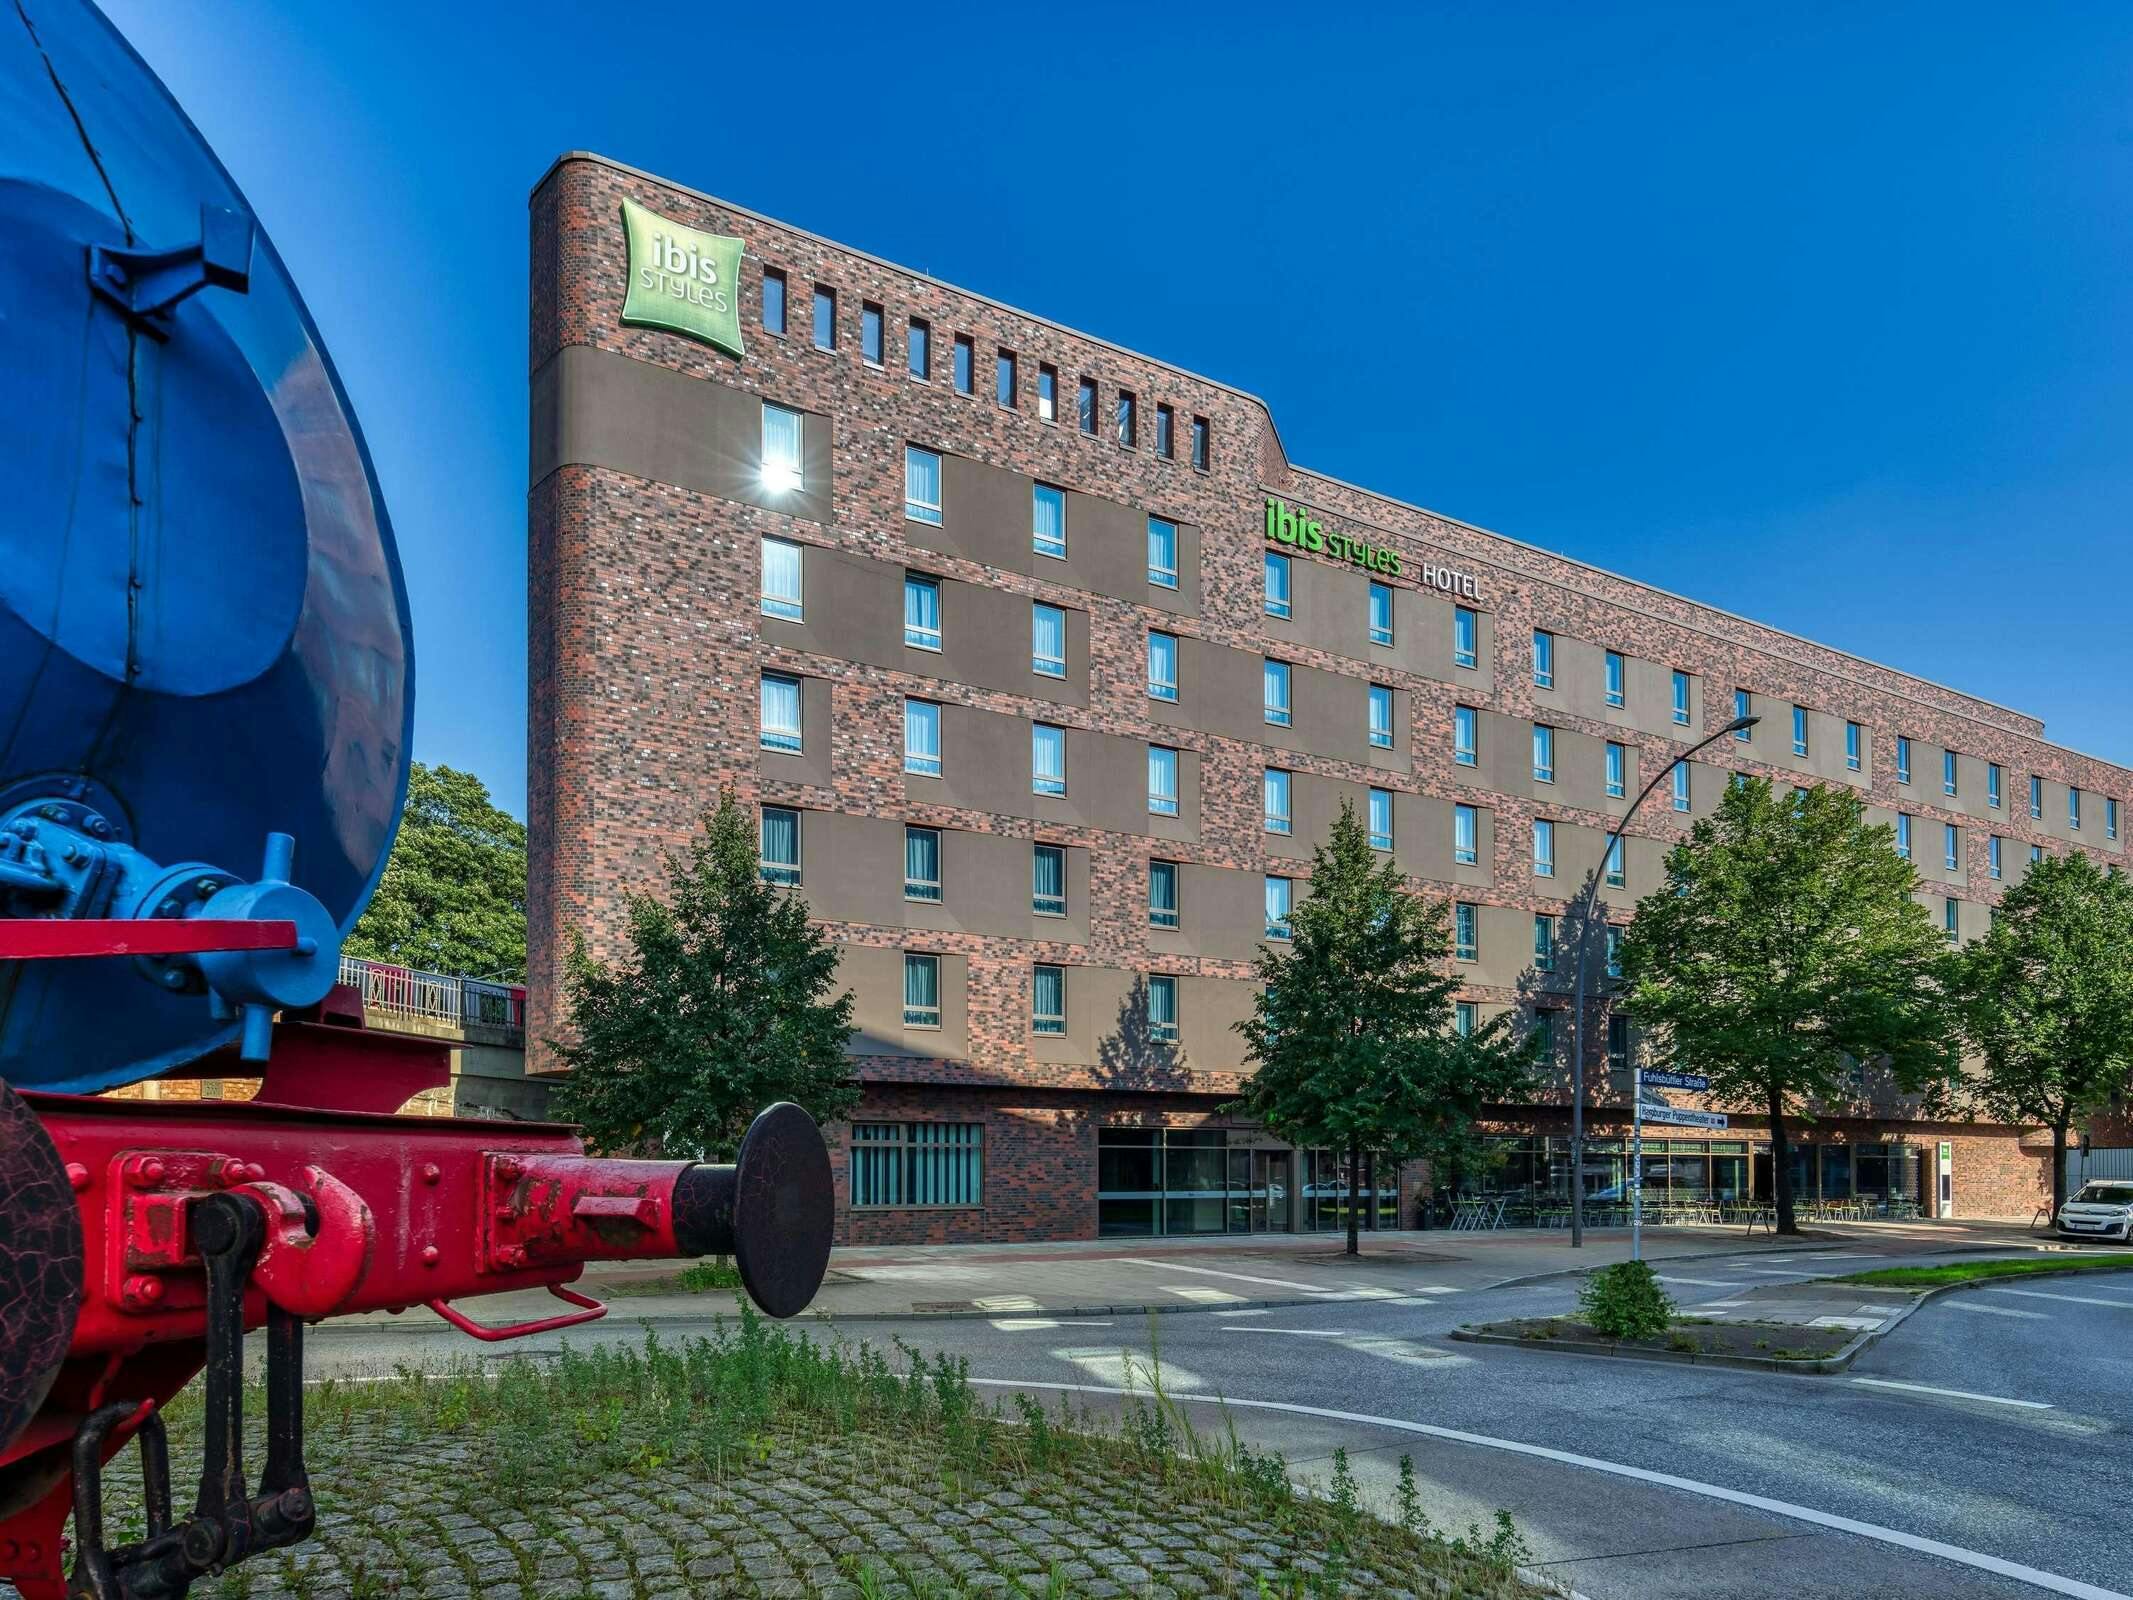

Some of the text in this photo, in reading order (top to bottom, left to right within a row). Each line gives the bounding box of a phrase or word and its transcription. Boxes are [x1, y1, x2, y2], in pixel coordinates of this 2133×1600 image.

[653, 232, 717, 285] ibis
[1265, 498, 1323, 551] ibis
[1423, 562, 1484, 601] HOTEL
[1643, 1071, 1706, 1089] Fuhlsbüttler Straße
